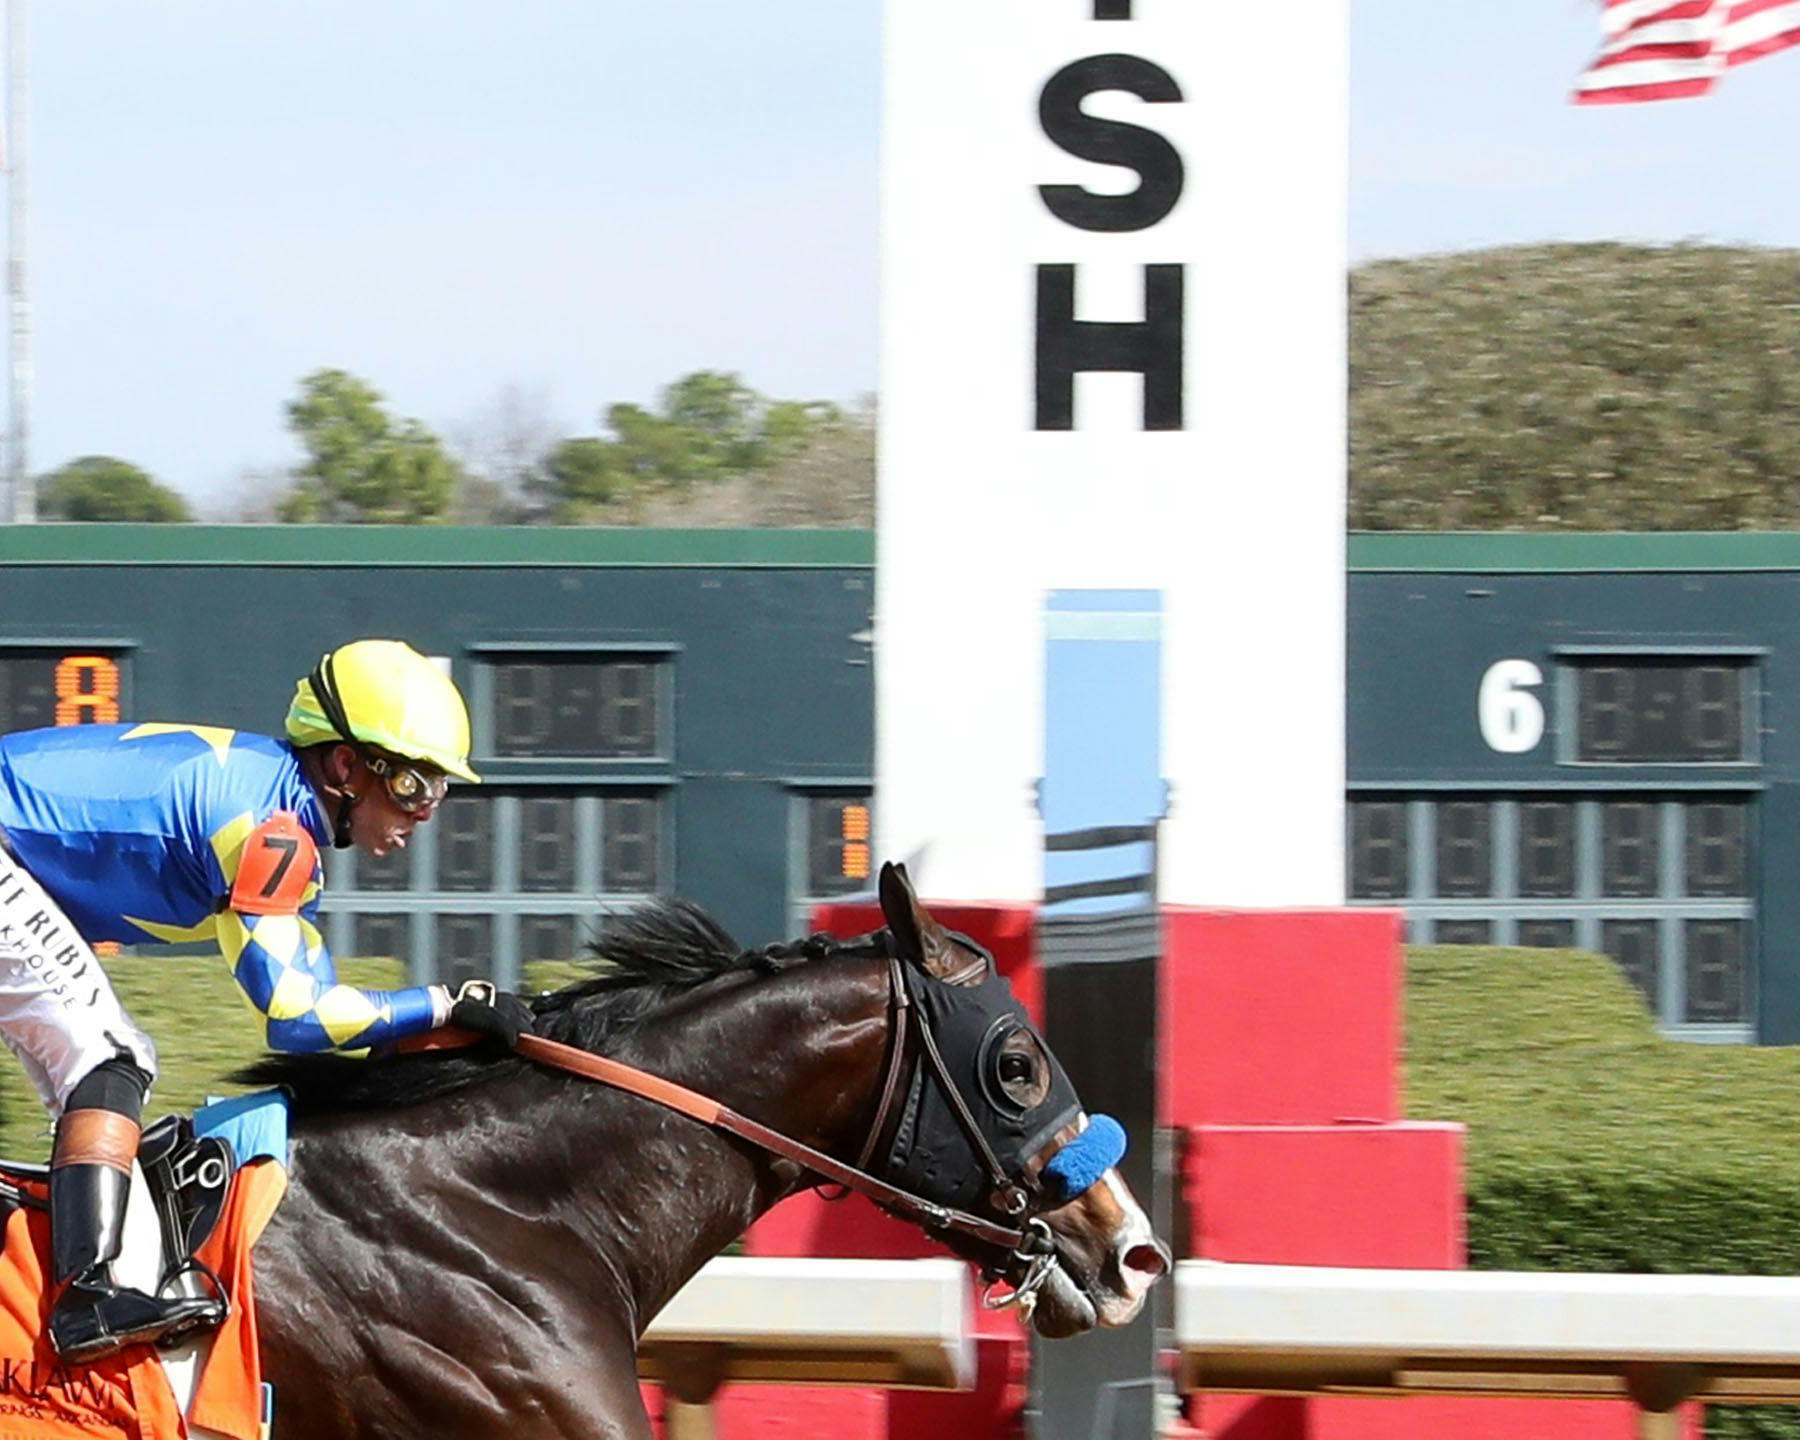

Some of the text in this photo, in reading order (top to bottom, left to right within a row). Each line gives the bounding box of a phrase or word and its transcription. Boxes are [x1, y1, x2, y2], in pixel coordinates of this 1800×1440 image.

[1035, 0, 1184, 431] SH
[1477, 659, 1545, 753] 6
[259, 836, 298, 898] 7
[24, 909, 100, 1008] RUBYS
